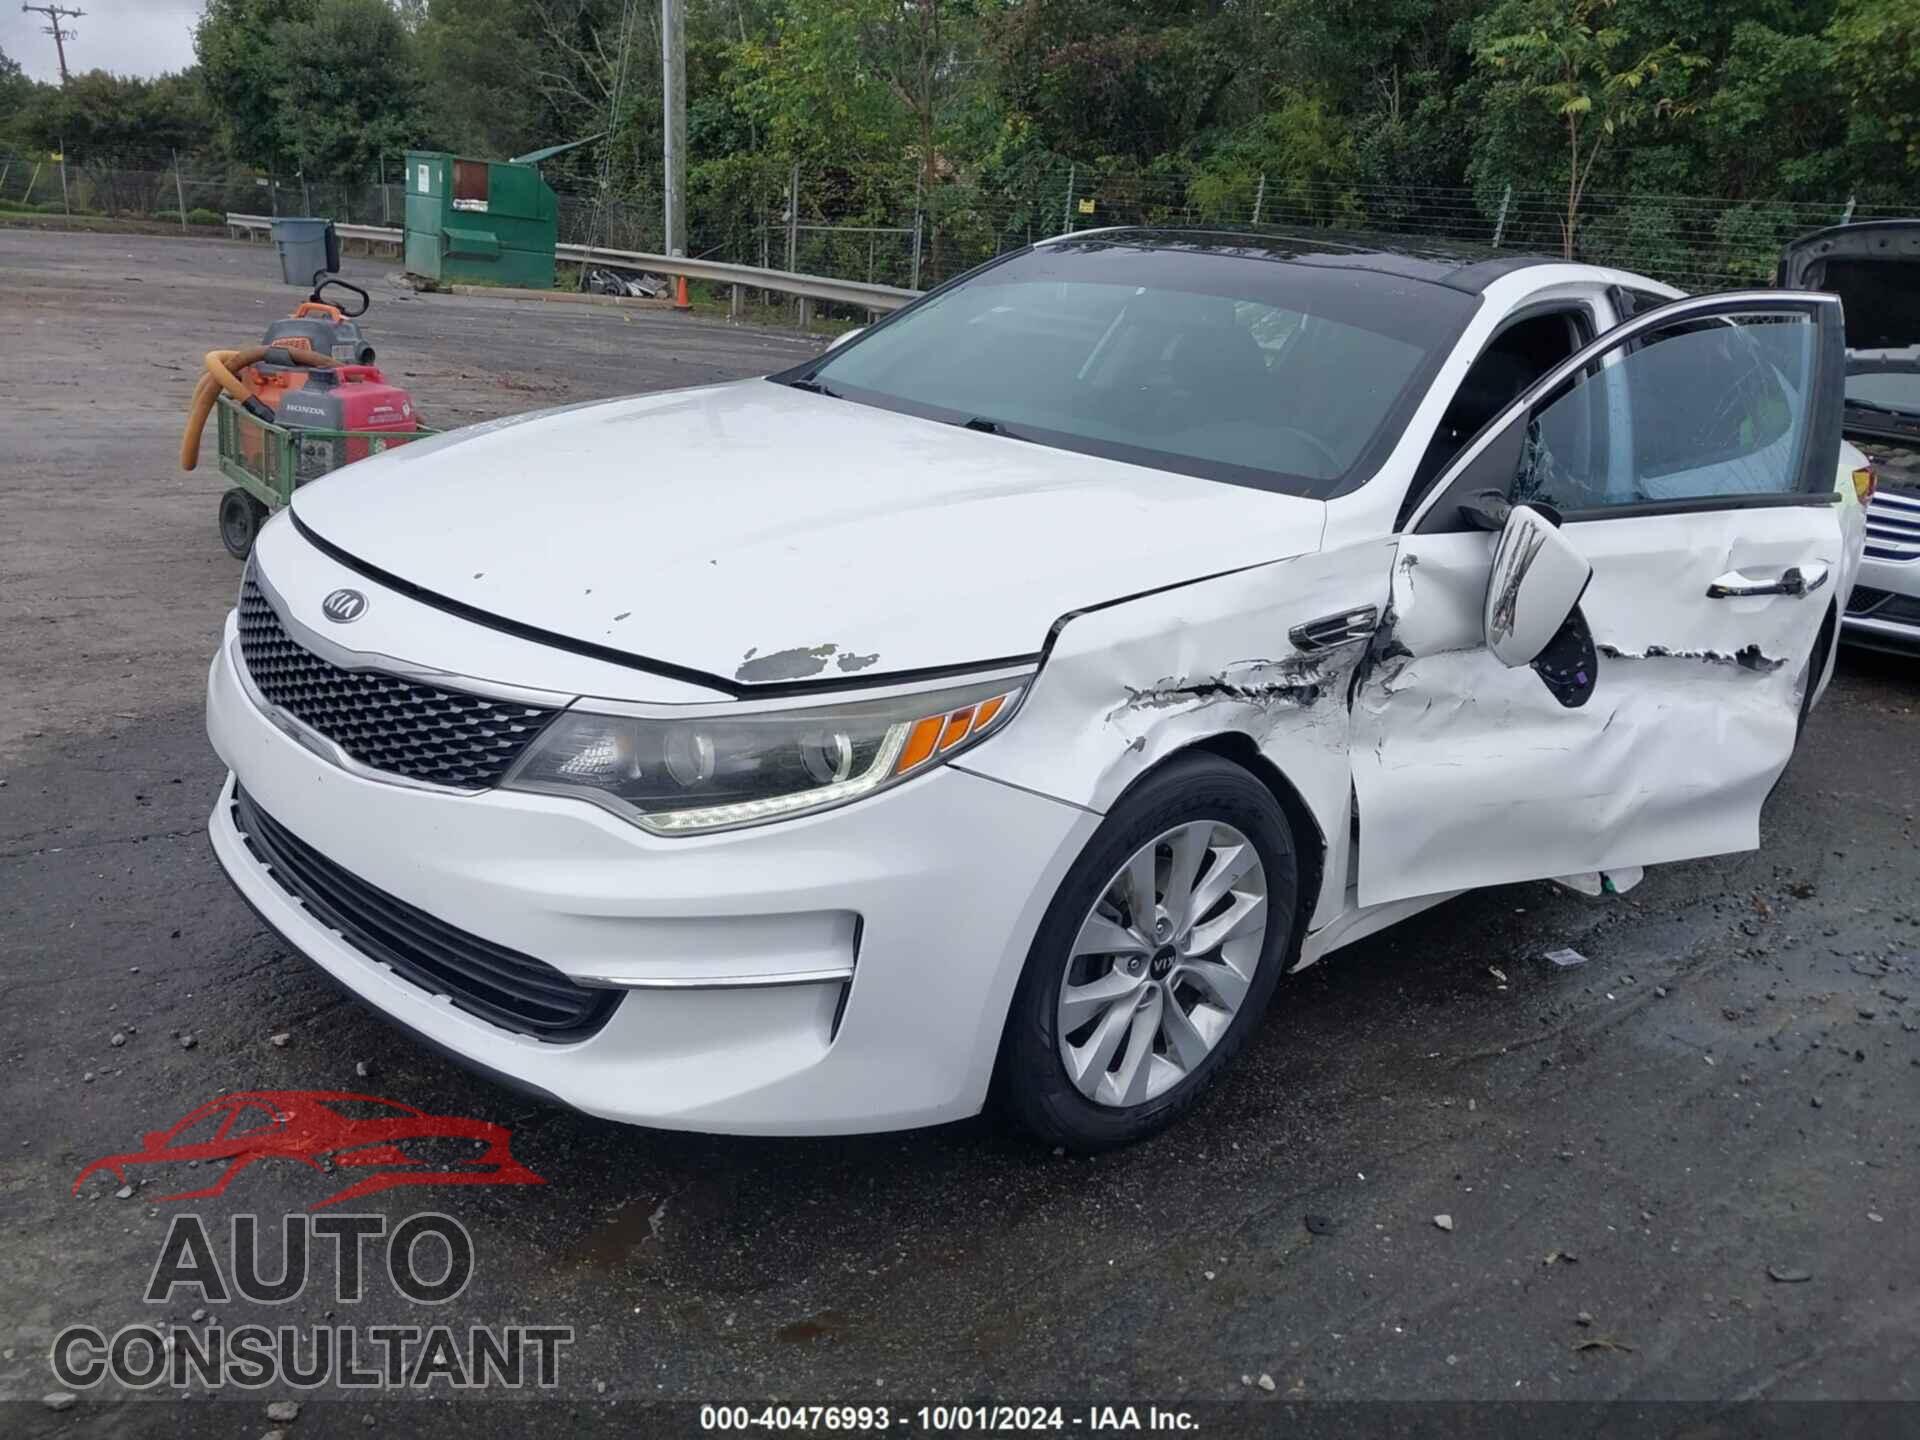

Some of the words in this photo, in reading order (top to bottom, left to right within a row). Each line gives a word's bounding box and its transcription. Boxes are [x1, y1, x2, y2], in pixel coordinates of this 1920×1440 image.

[286, 404, 326, 416] HONDA
[324, 592, 358, 618] KIA
[1154, 956, 1174, 971] KIA
